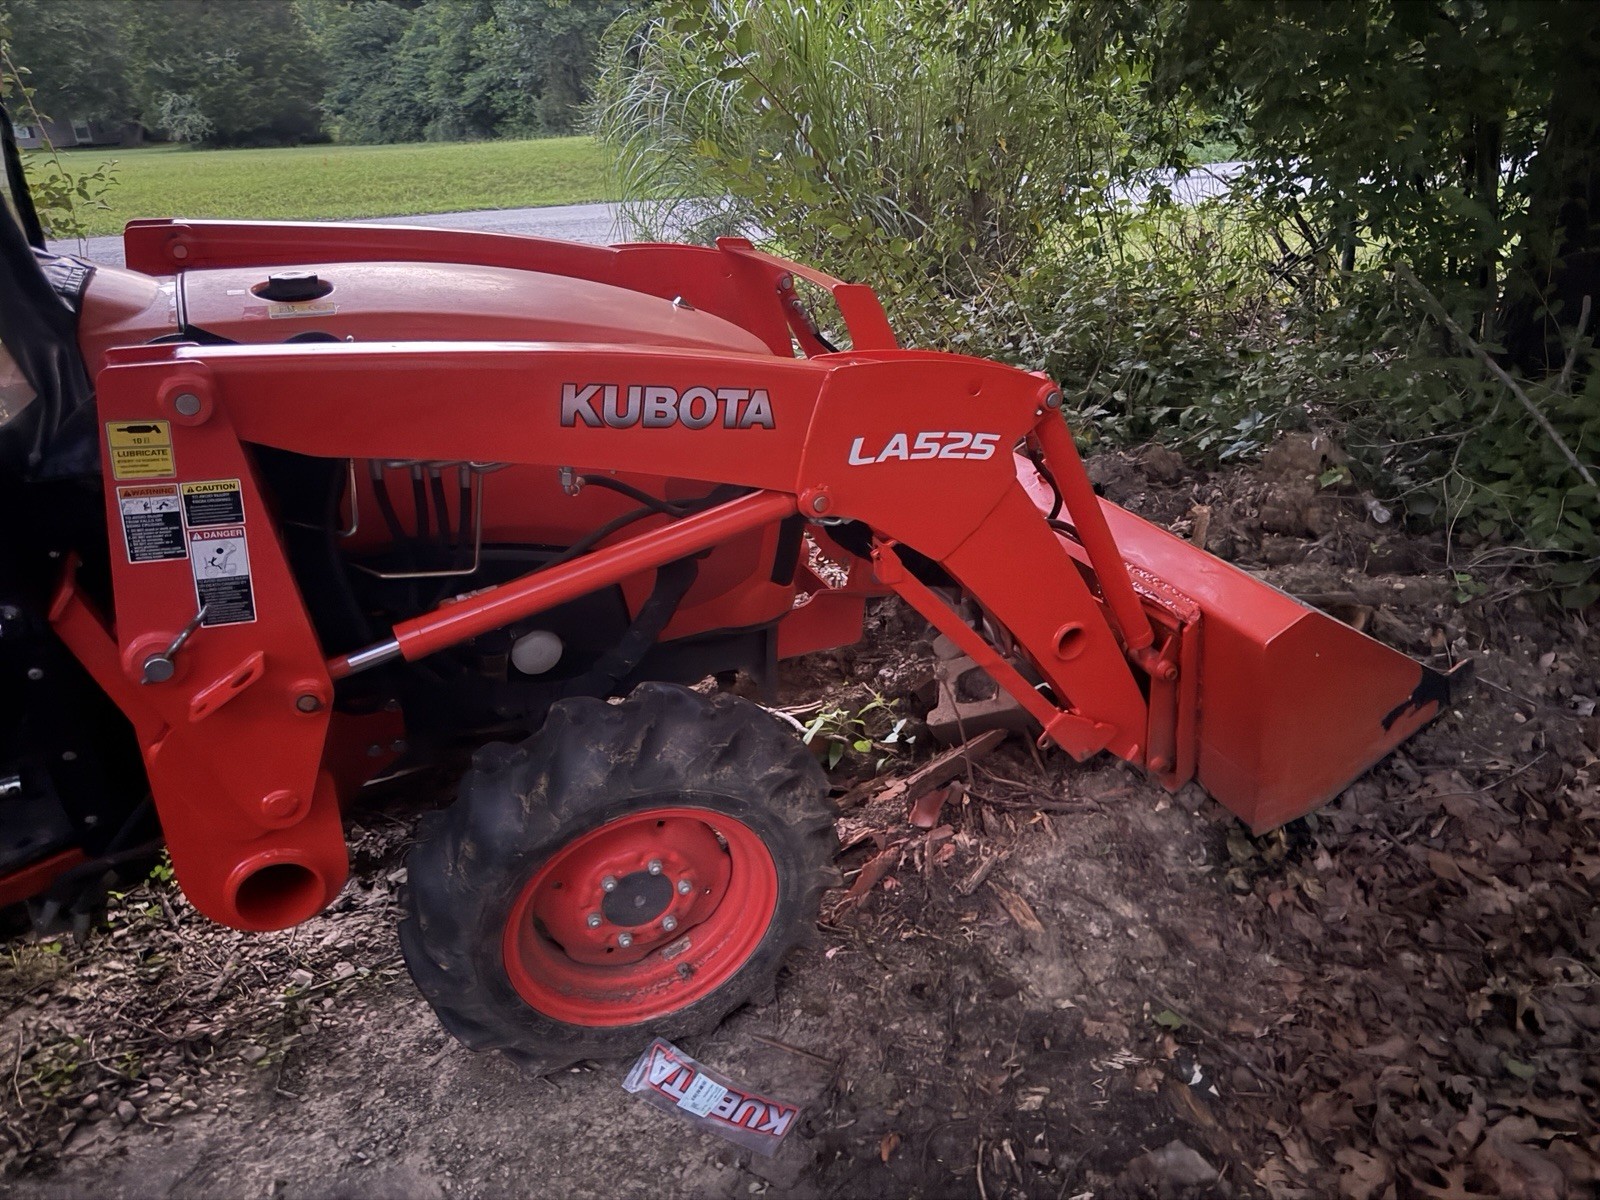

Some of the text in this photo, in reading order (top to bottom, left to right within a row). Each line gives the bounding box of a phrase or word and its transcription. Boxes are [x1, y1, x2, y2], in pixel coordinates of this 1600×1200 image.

[560, 382, 776, 430] KUBOTA
[117, 449, 168, 458] LUBRICATE
[848, 431, 1001, 466] LA525
[131, 487, 174, 496] WARNING
[195, 483, 236, 492] CAUTION
[203, 529, 243, 539] DANGER
[649, 1046, 796, 1137] KUBTA
